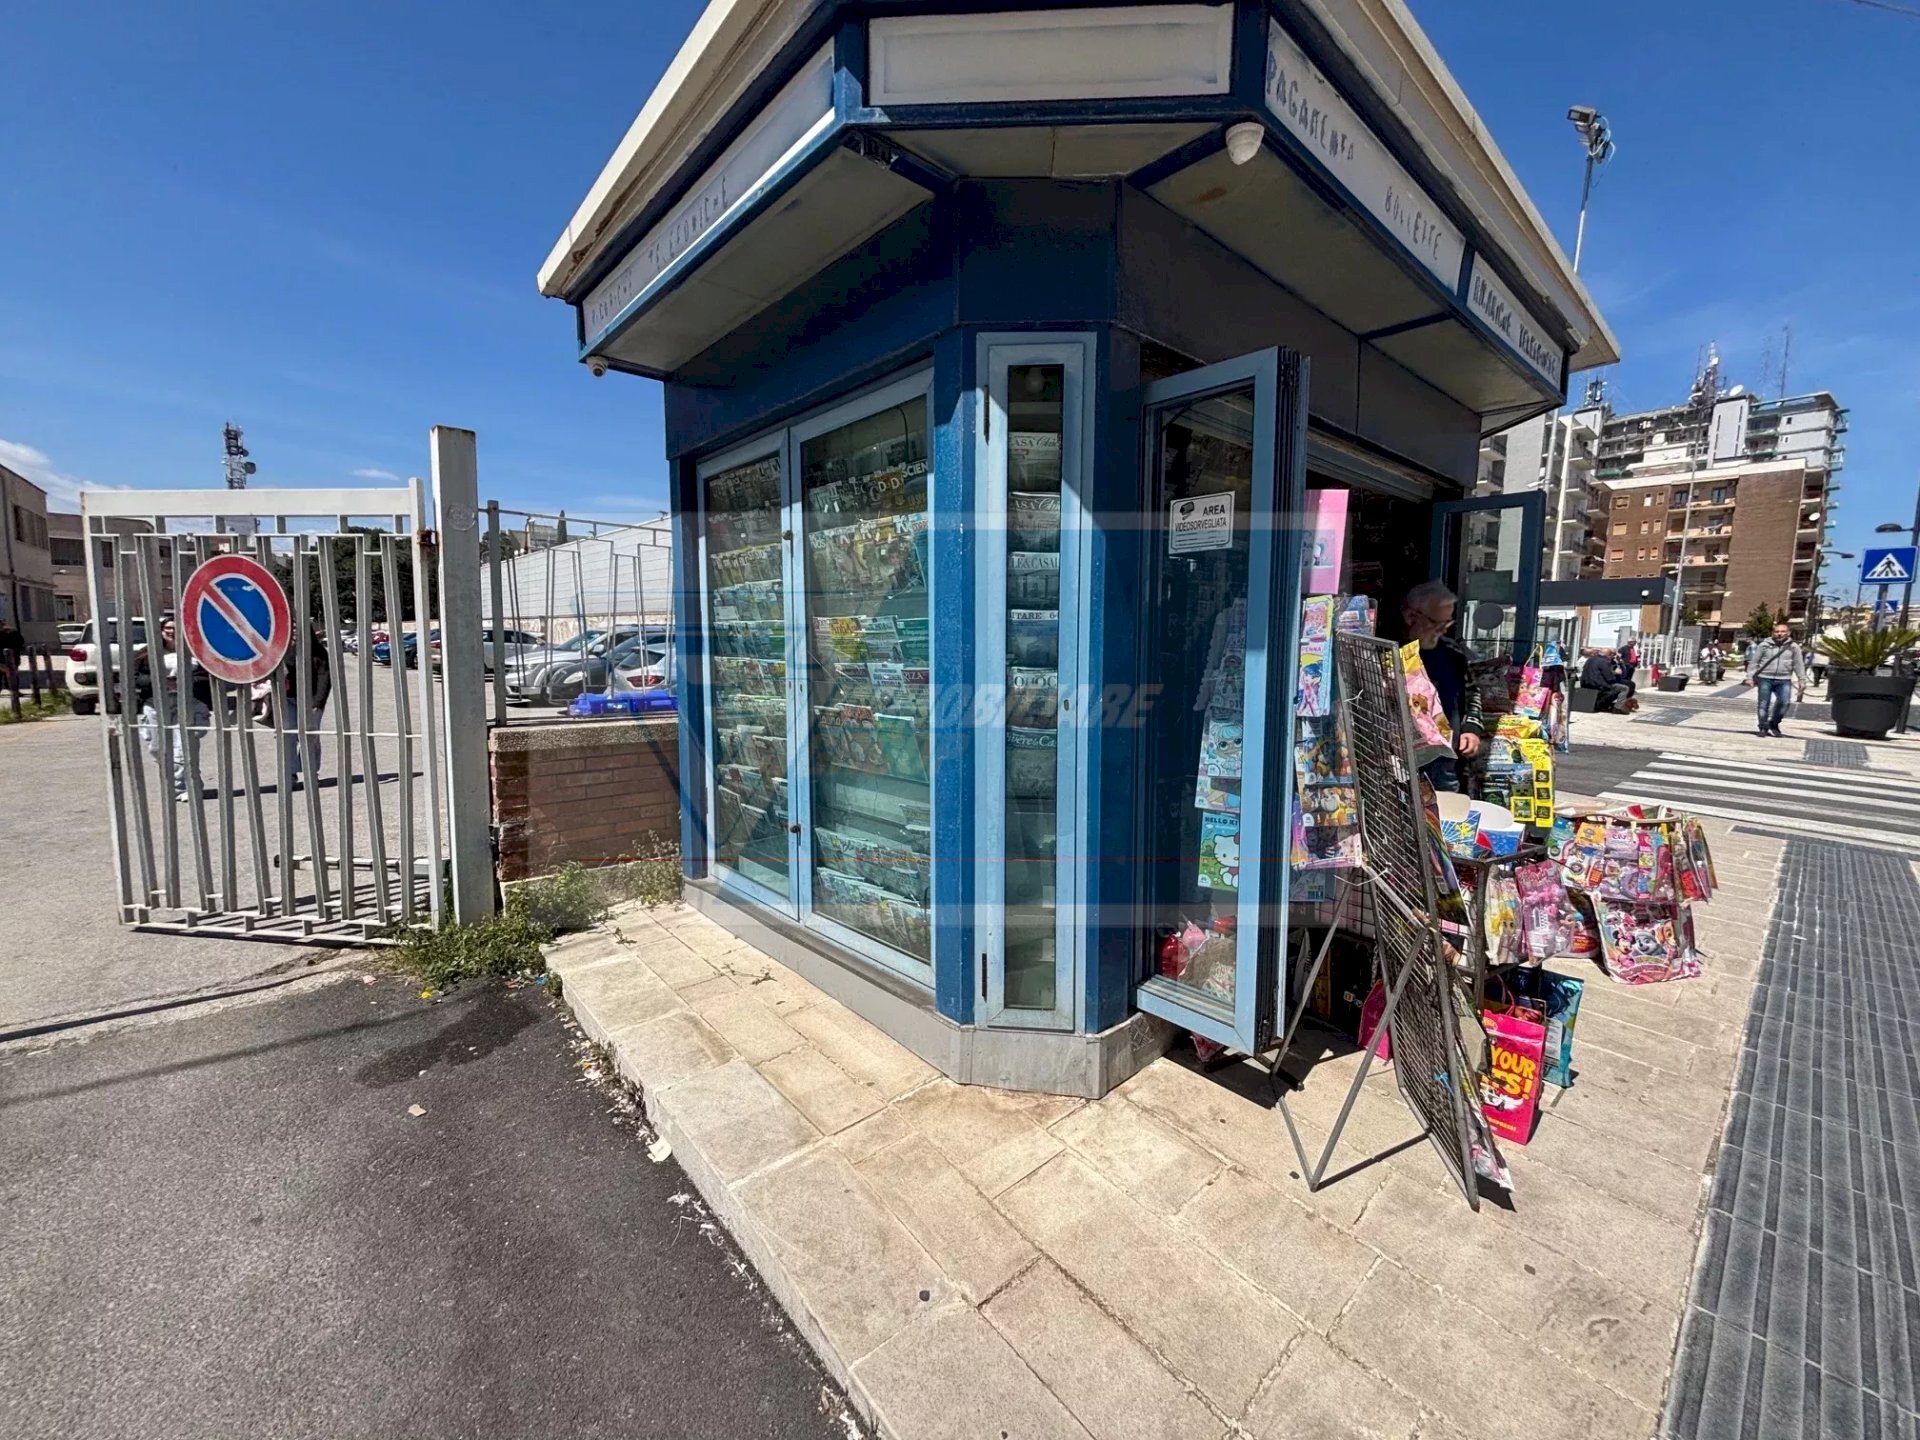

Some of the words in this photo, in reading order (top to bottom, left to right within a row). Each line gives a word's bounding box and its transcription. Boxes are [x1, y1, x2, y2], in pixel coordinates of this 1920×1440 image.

[1202, 504, 1226, 517] AREA
[1174, 516, 1227, 532] VIDEOSORVEGLIATA
[1204, 816, 1228, 825] HELLO
[1490, 1045, 1537, 1080] YOUR
